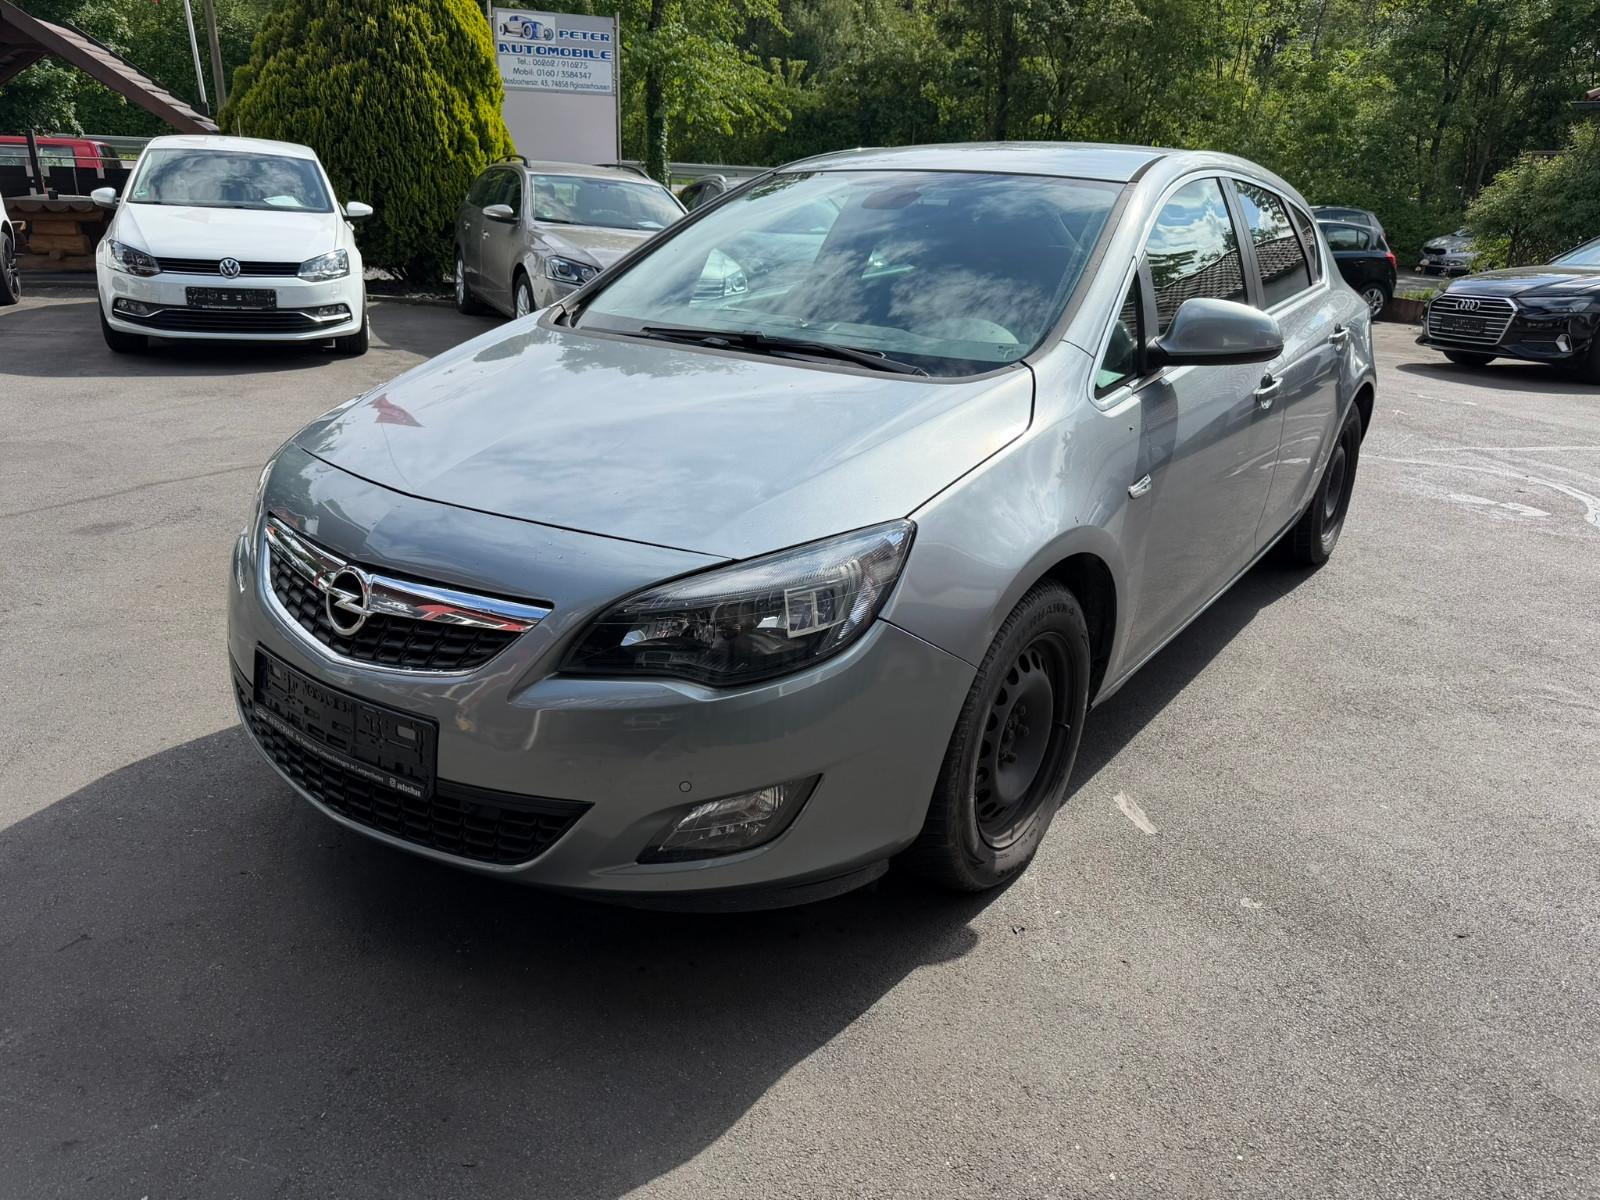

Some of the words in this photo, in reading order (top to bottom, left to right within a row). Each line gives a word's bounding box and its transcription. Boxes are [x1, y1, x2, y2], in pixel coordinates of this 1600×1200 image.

[558, 30, 610, 41] PETER
[498, 43, 612, 59] AUTOMOBILE
[517, 58, 531, 66] Tel.:
[532, 58, 555, 67] 06262
[561, 60, 588, 69] 916275
[513, 67, 535, 76] Mobil:
[536, 69, 555, 78] 0160
[561, 70, 592, 79] 3584347
[551, 80, 569, 88] 74858
